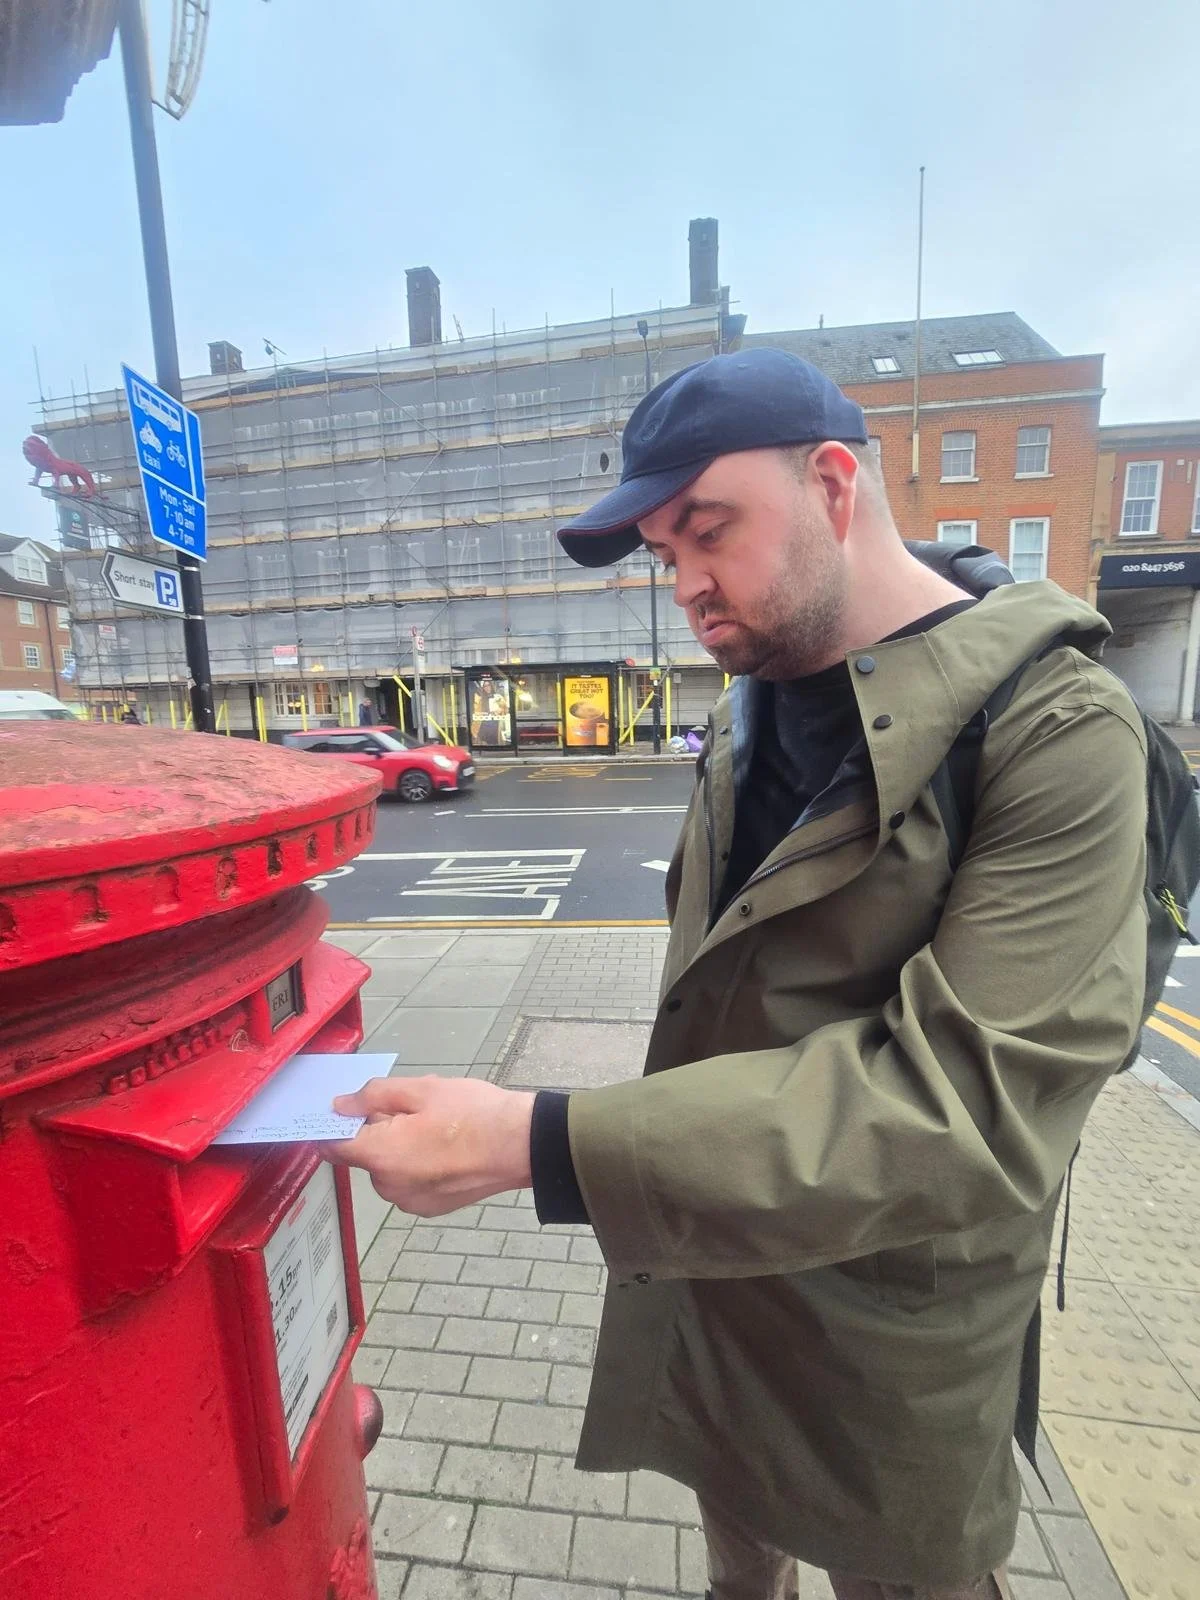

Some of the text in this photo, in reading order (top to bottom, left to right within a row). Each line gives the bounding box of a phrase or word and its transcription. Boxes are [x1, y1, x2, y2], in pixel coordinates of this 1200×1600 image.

[143, 450, 162, 470] taxi
[114, 570, 174, 603] Short stay P
[367, 858, 583, 922] LANE
[272, 989, 289, 1011] FRI
